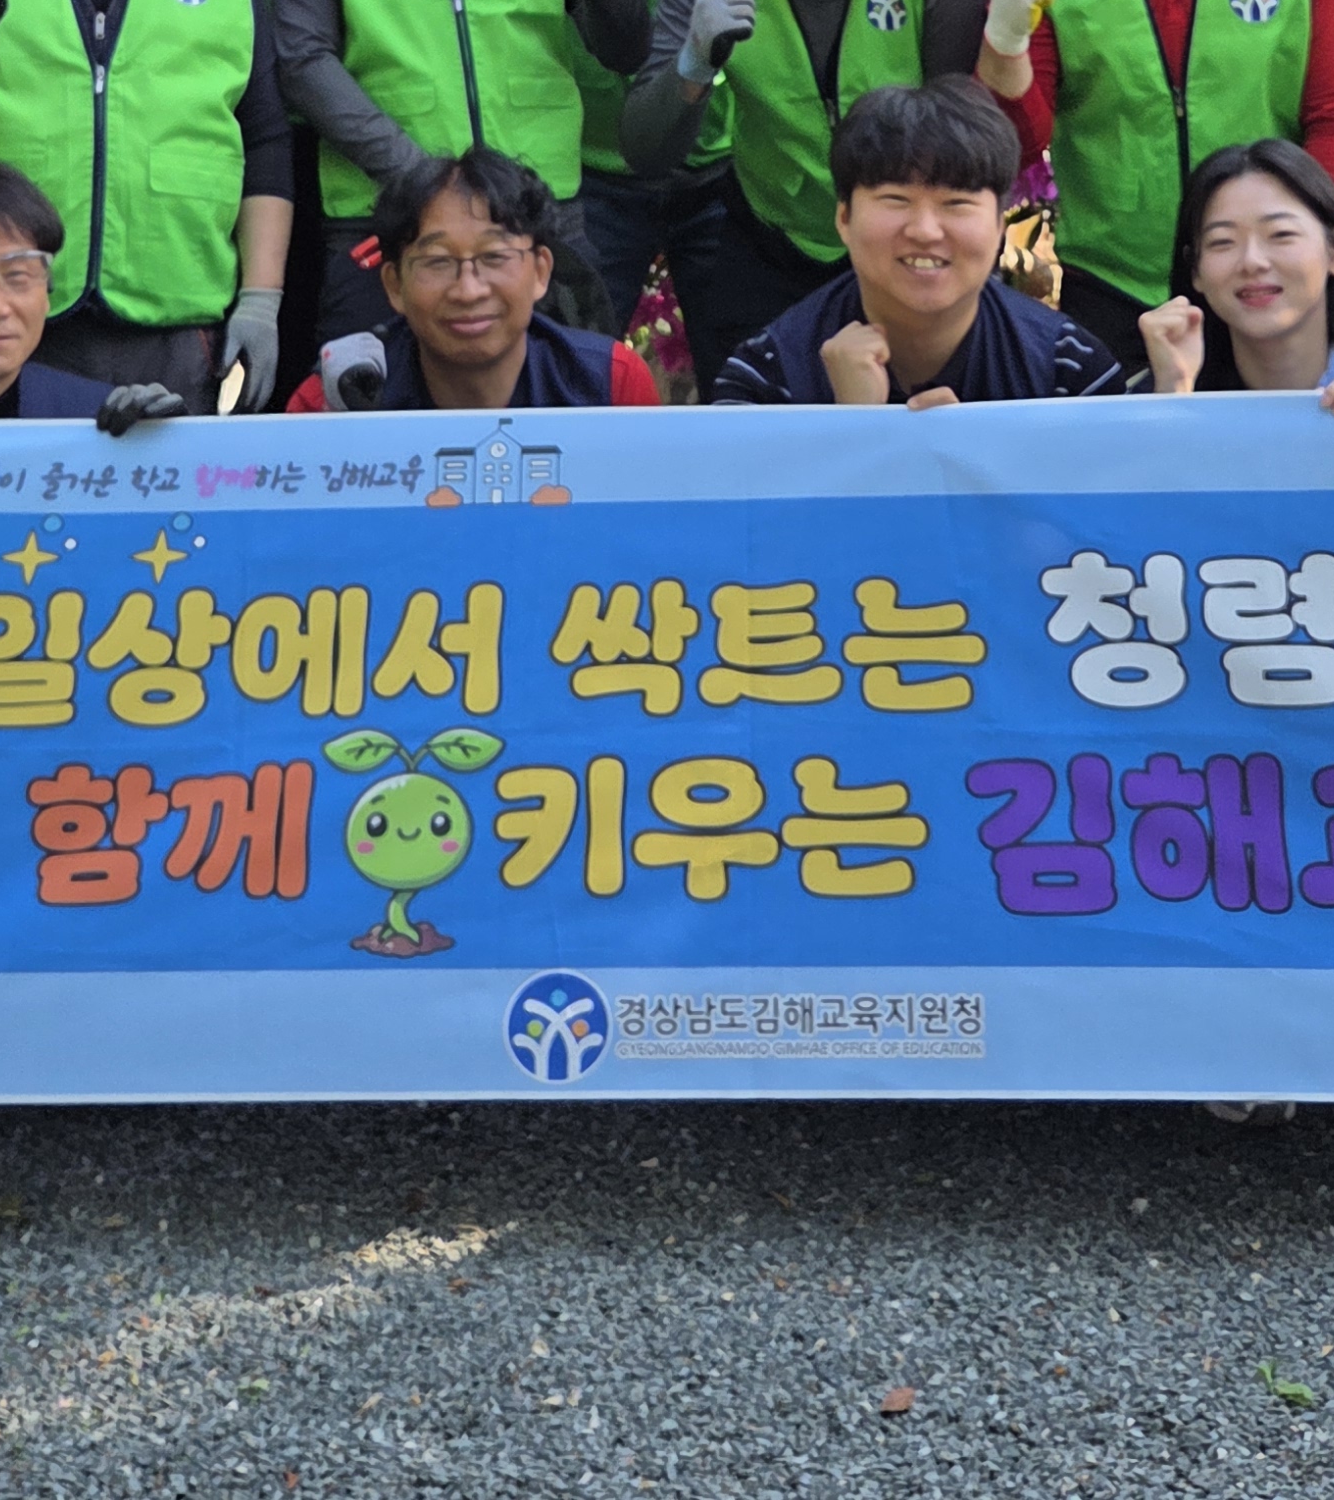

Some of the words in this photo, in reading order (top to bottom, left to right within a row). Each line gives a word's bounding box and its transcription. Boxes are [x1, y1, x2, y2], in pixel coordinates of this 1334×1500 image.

[41, 462, 118, 500] 즐거운
[131, 465, 181, 498] 학교
[195, 461, 307, 498] 함께하는
[320, 454, 425, 494] 김해교육
[550, 577, 988, 715] 싹트는
[26, 759, 315, 906] 함께
[493, 754, 930, 902] 키우는
[617, 995, 983, 1036] 경상남도김해교육지원청
[773, 1041, 829, 1056] GIMHAE
[831, 1041, 877, 1056] OFFICE
[881, 1041, 900, 1056] OF
[903, 1041, 983, 1056] EDUCATION
